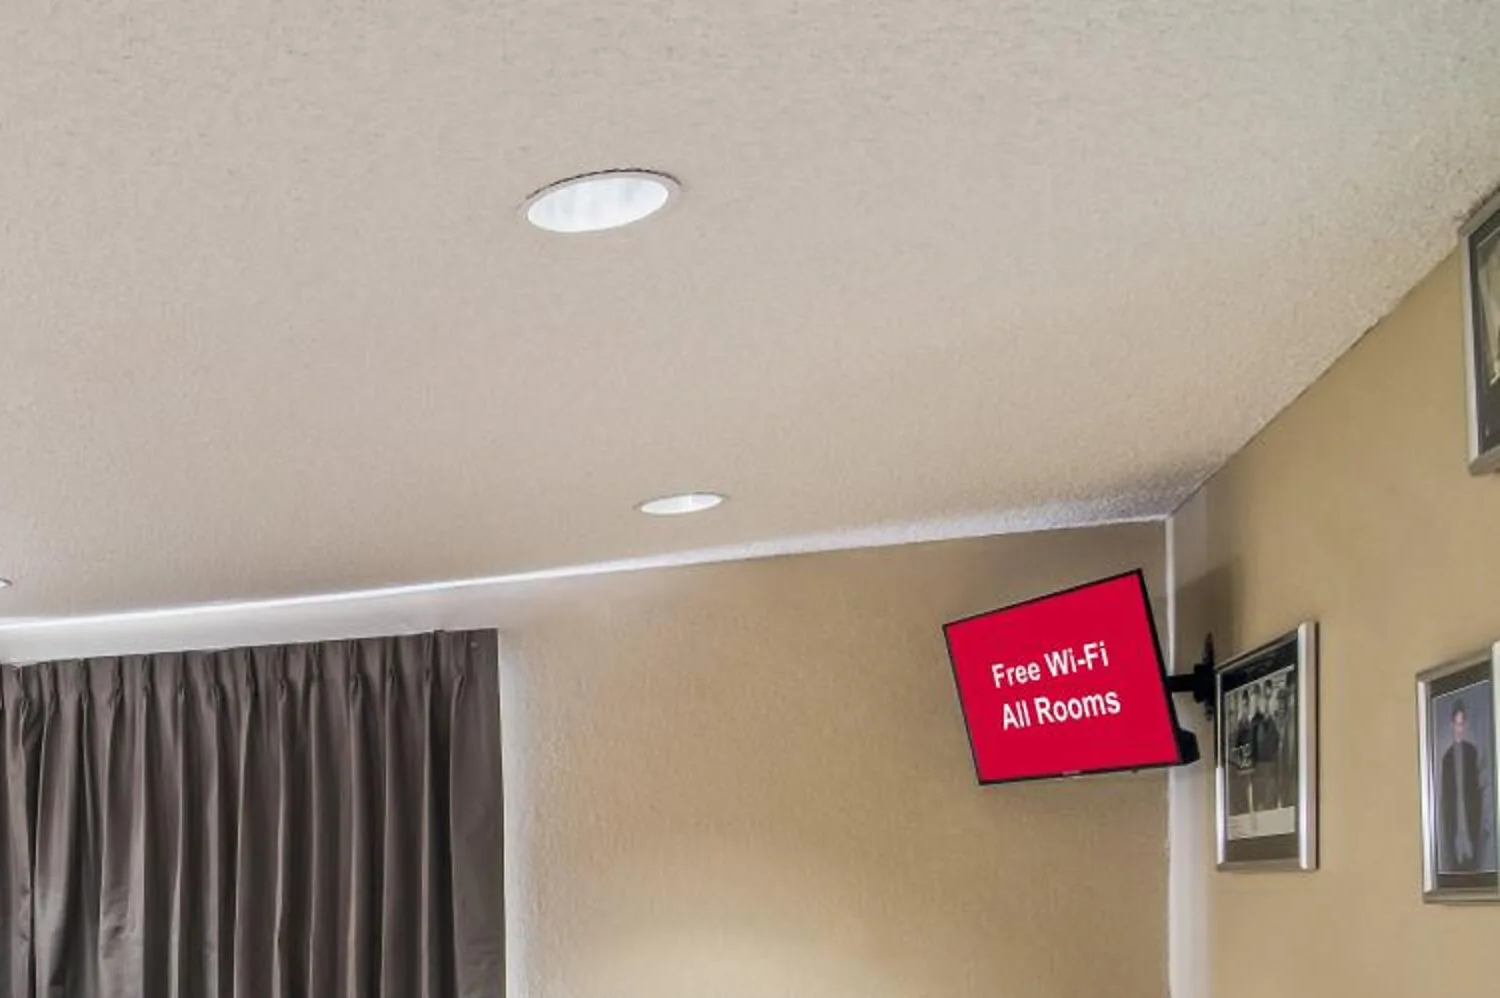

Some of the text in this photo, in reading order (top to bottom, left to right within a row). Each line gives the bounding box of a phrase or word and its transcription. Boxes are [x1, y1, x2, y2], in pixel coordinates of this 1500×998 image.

[991, 641, 1109, 688] Free Wi-Fi
[1002, 691, 1121, 730] All Rooms
